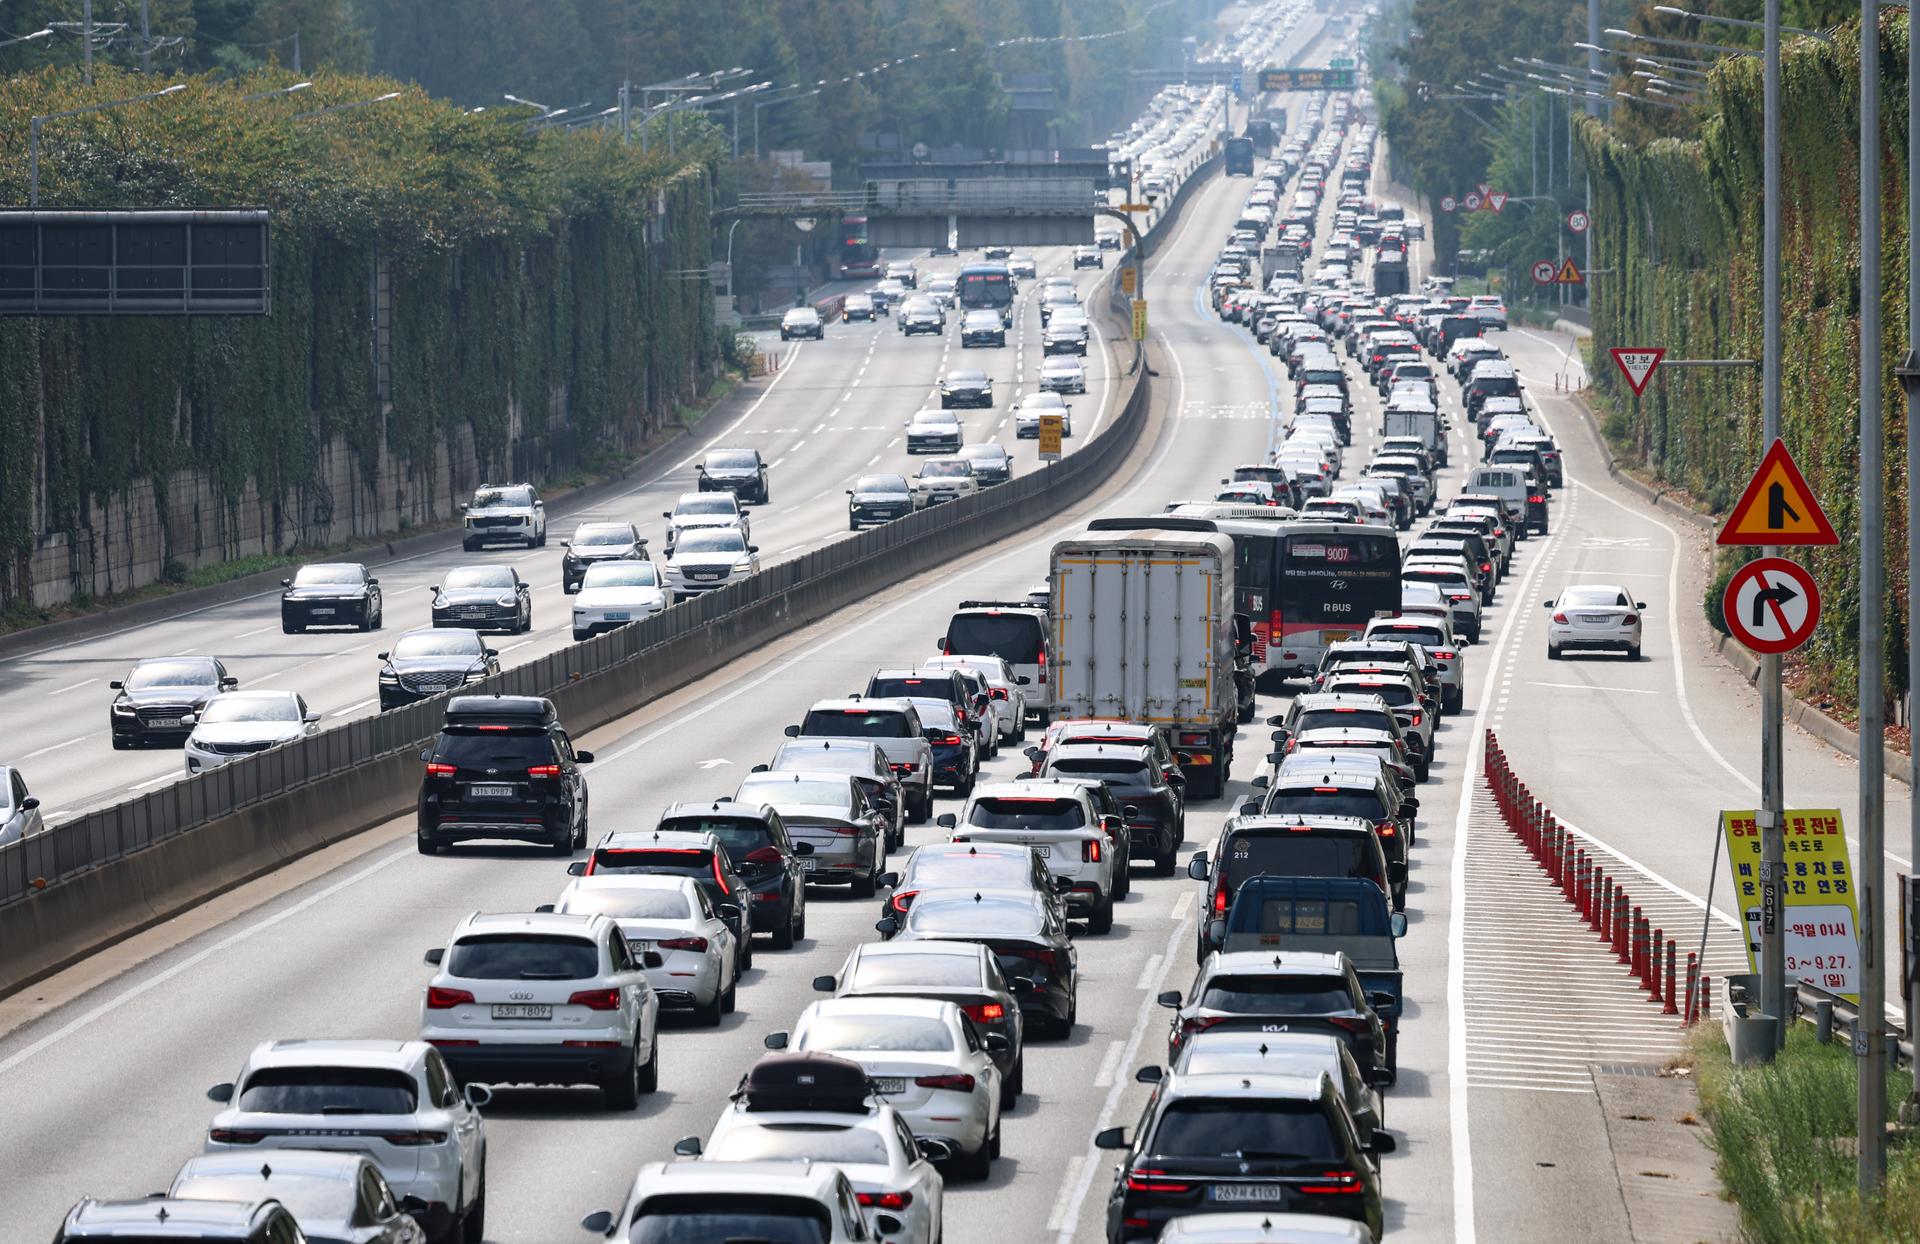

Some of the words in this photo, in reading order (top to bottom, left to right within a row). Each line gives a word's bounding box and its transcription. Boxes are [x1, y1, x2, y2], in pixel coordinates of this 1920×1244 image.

[1625, 355, 1650, 364] 양보
[1327, 548, 1348, 560] 9007
[1323, 603, 1331, 612] R
[1332, 603, 1352, 612] BUS
[1730, 819, 1758, 837] 명절
[1792, 817, 1807, 836] 및
[1810, 817, 1837, 835] 전날
[1751, 839, 1825, 854] 경속도로
[1234, 851, 1249, 859] 212
[1817, 879, 1848, 895] 연장
[1819, 922, 1846, 937] 01시
[521, 1005, 548, 1017] 1809
[1262, 1024, 1288, 1032] KIA
